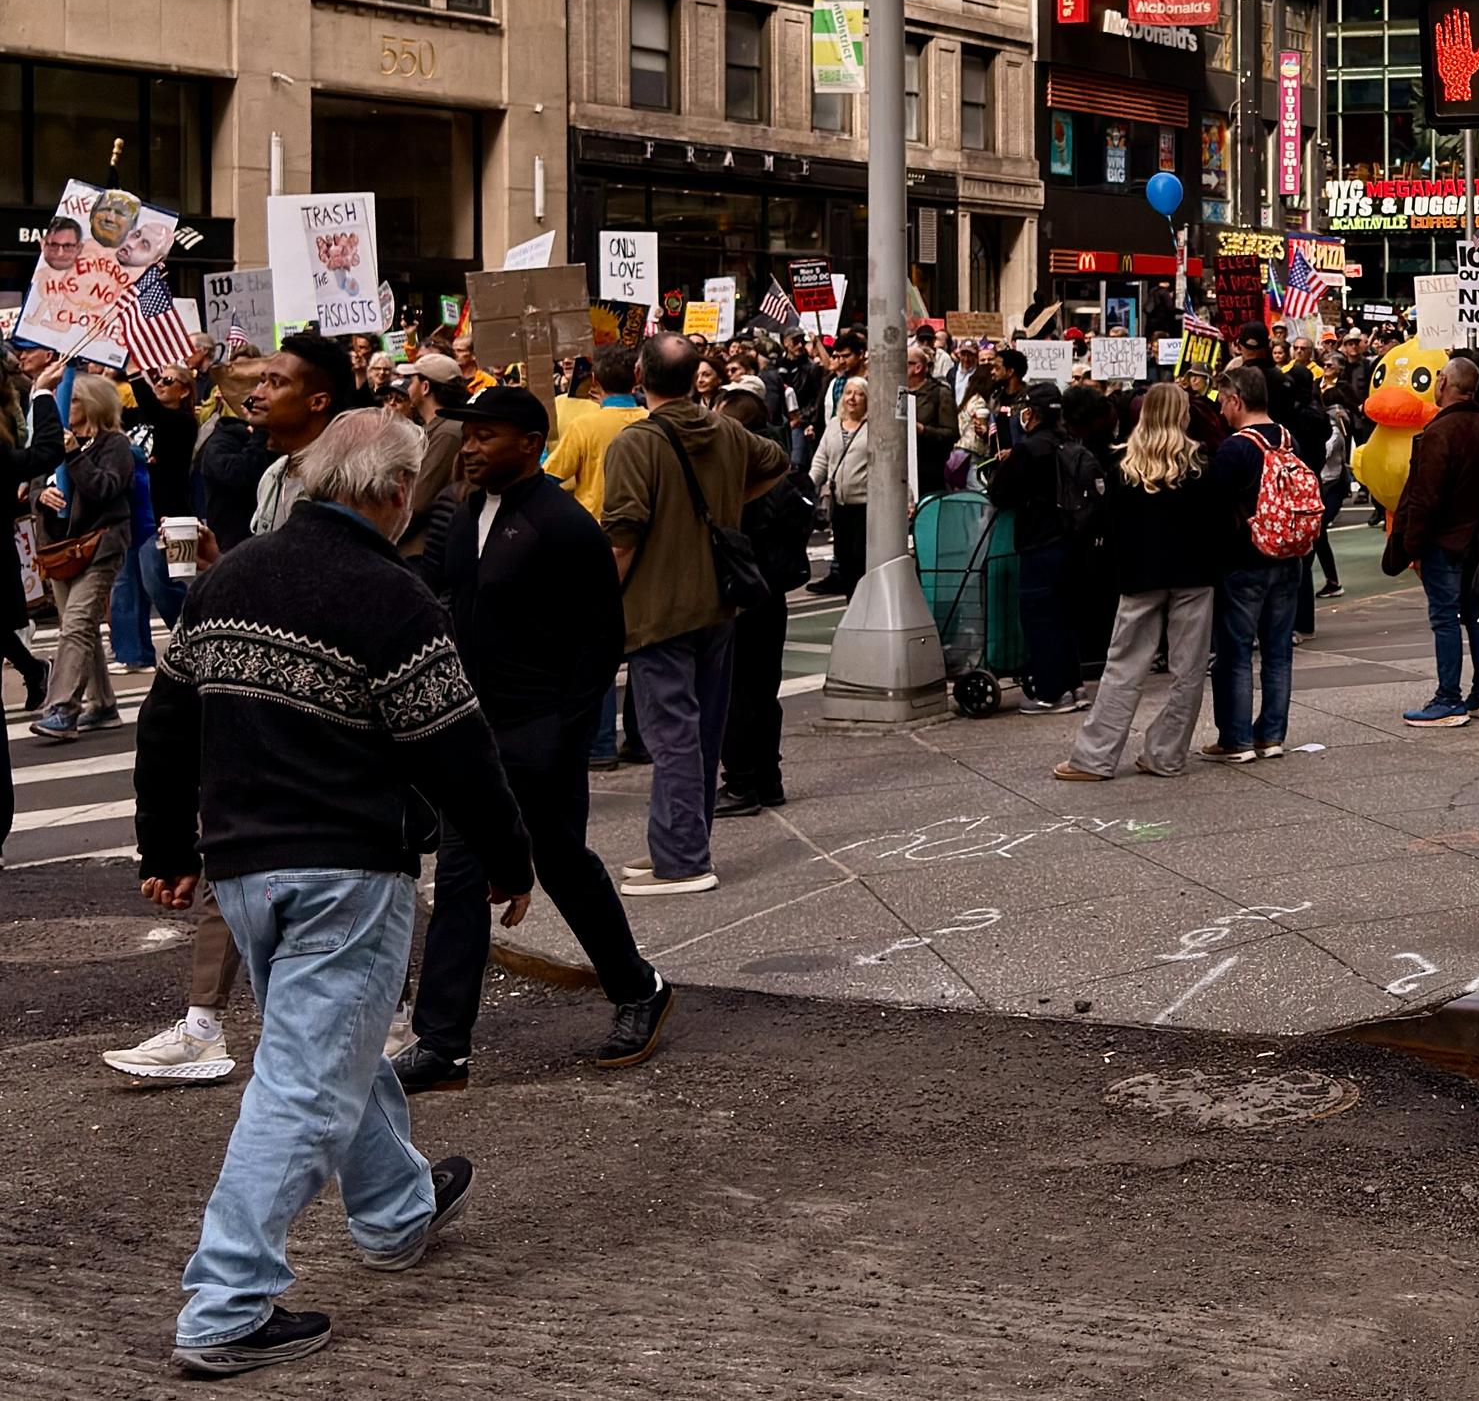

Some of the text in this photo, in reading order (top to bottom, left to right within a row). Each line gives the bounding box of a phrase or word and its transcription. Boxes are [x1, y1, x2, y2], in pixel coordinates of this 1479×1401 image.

[1135, 0, 1212, 16] McDonald's
[833, 3, 853, 59] ntDistrict
[379, 34, 438, 81] 550
[1282, 79, 1298, 191] MIDTOWN COMICS
[643, 141, 811, 176] FRAME
[1106, 168, 1125, 183] BIG
[1326, 179, 1364, 199] NYC
[60, 196, 92, 215] THE
[1328, 197, 1373, 217] IFTS
[1380, 197, 1398, 214] &
[301, 202, 358, 229] TRASH
[1410, 215, 1458, 229] COFFEE
[609, 237, 637, 258] ONLY
[75, 257, 133, 289] EMPERO
[609, 261, 645, 280] LOVE
[1219, 257, 1257, 270] ELECT
[46, 276, 115, 304] HAS NO
[312, 272, 329, 290] THE
[623, 282, 635, 296] IS
[316, 299, 378, 328] FASCISTS
[1023, 347, 1065, 360] ABOLISH
[1099, 339, 1141, 352] TRUMP
[1166, 341, 1181, 349] VOT
[1032, 359, 1057, 371] ICE
[1095, 351, 1107, 362] IS
[1100, 362, 1138, 377] KING
